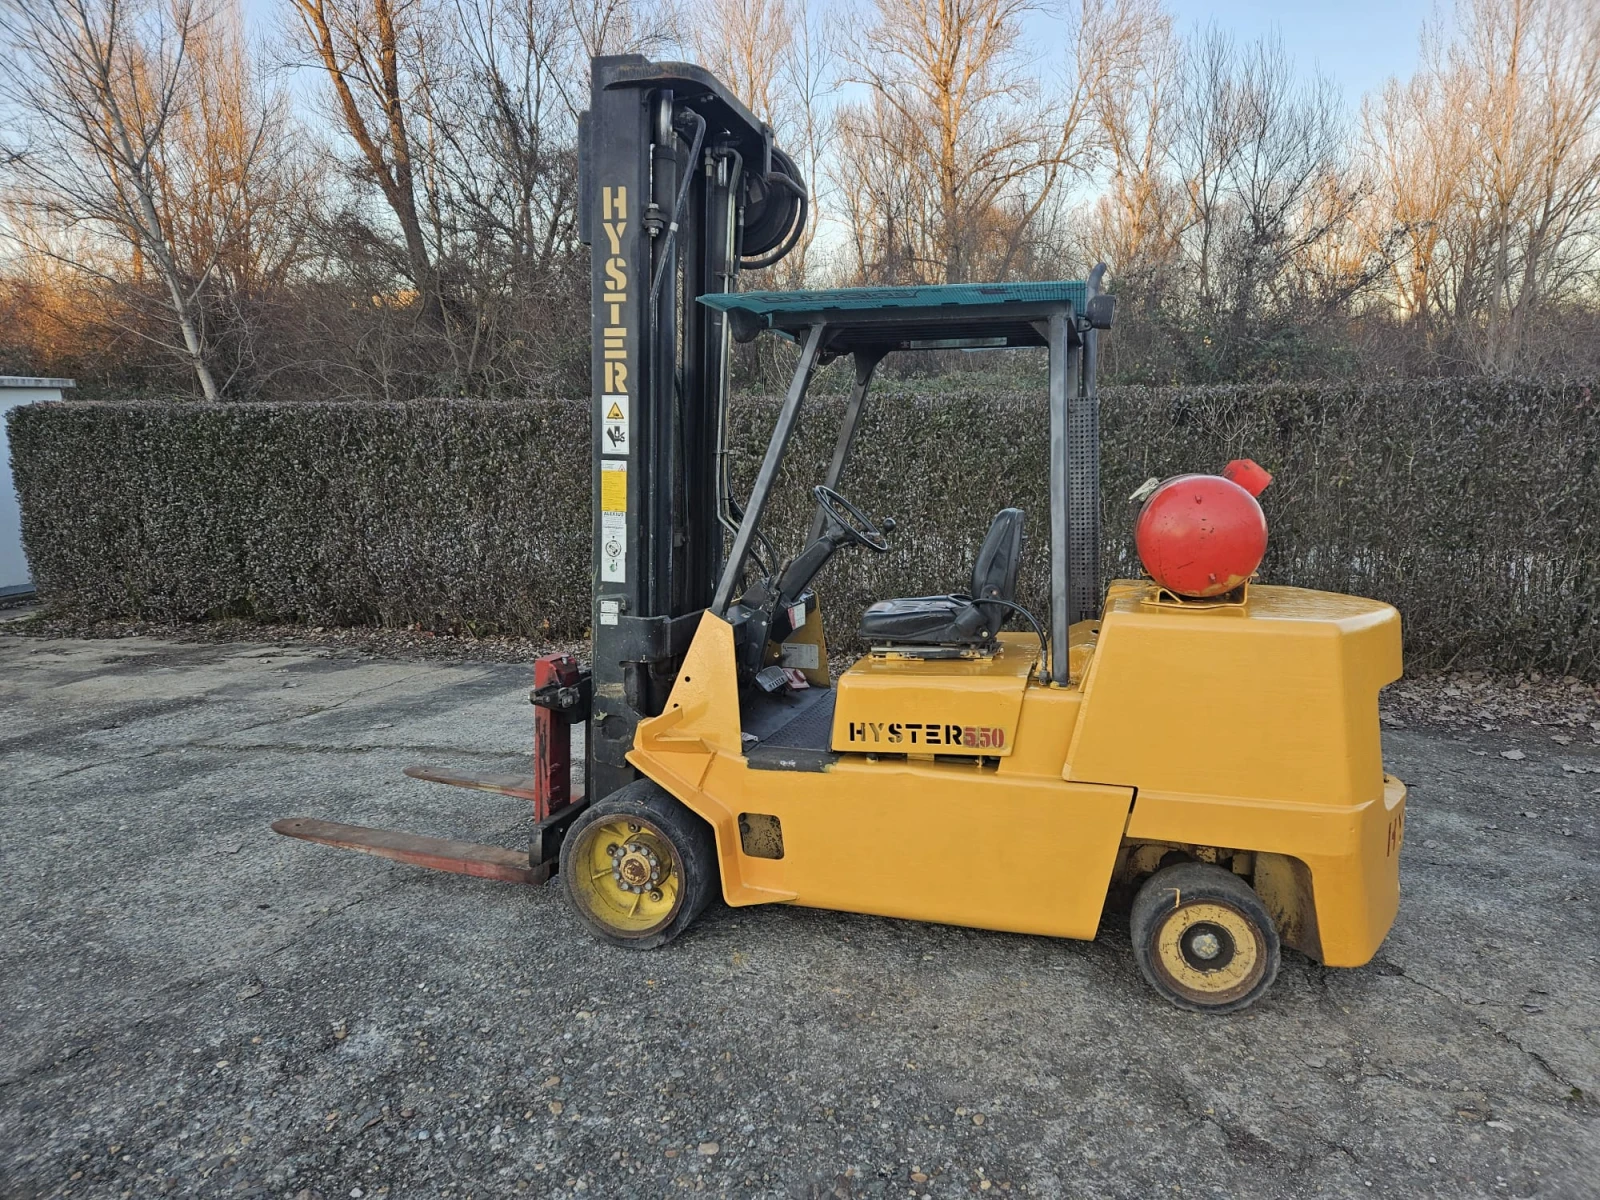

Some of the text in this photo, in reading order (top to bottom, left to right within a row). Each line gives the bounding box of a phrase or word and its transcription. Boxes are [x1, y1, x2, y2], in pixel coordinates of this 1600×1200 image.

[602, 186, 628, 393] HYSTER
[849, 722, 1005, 748] HYSTER 550
